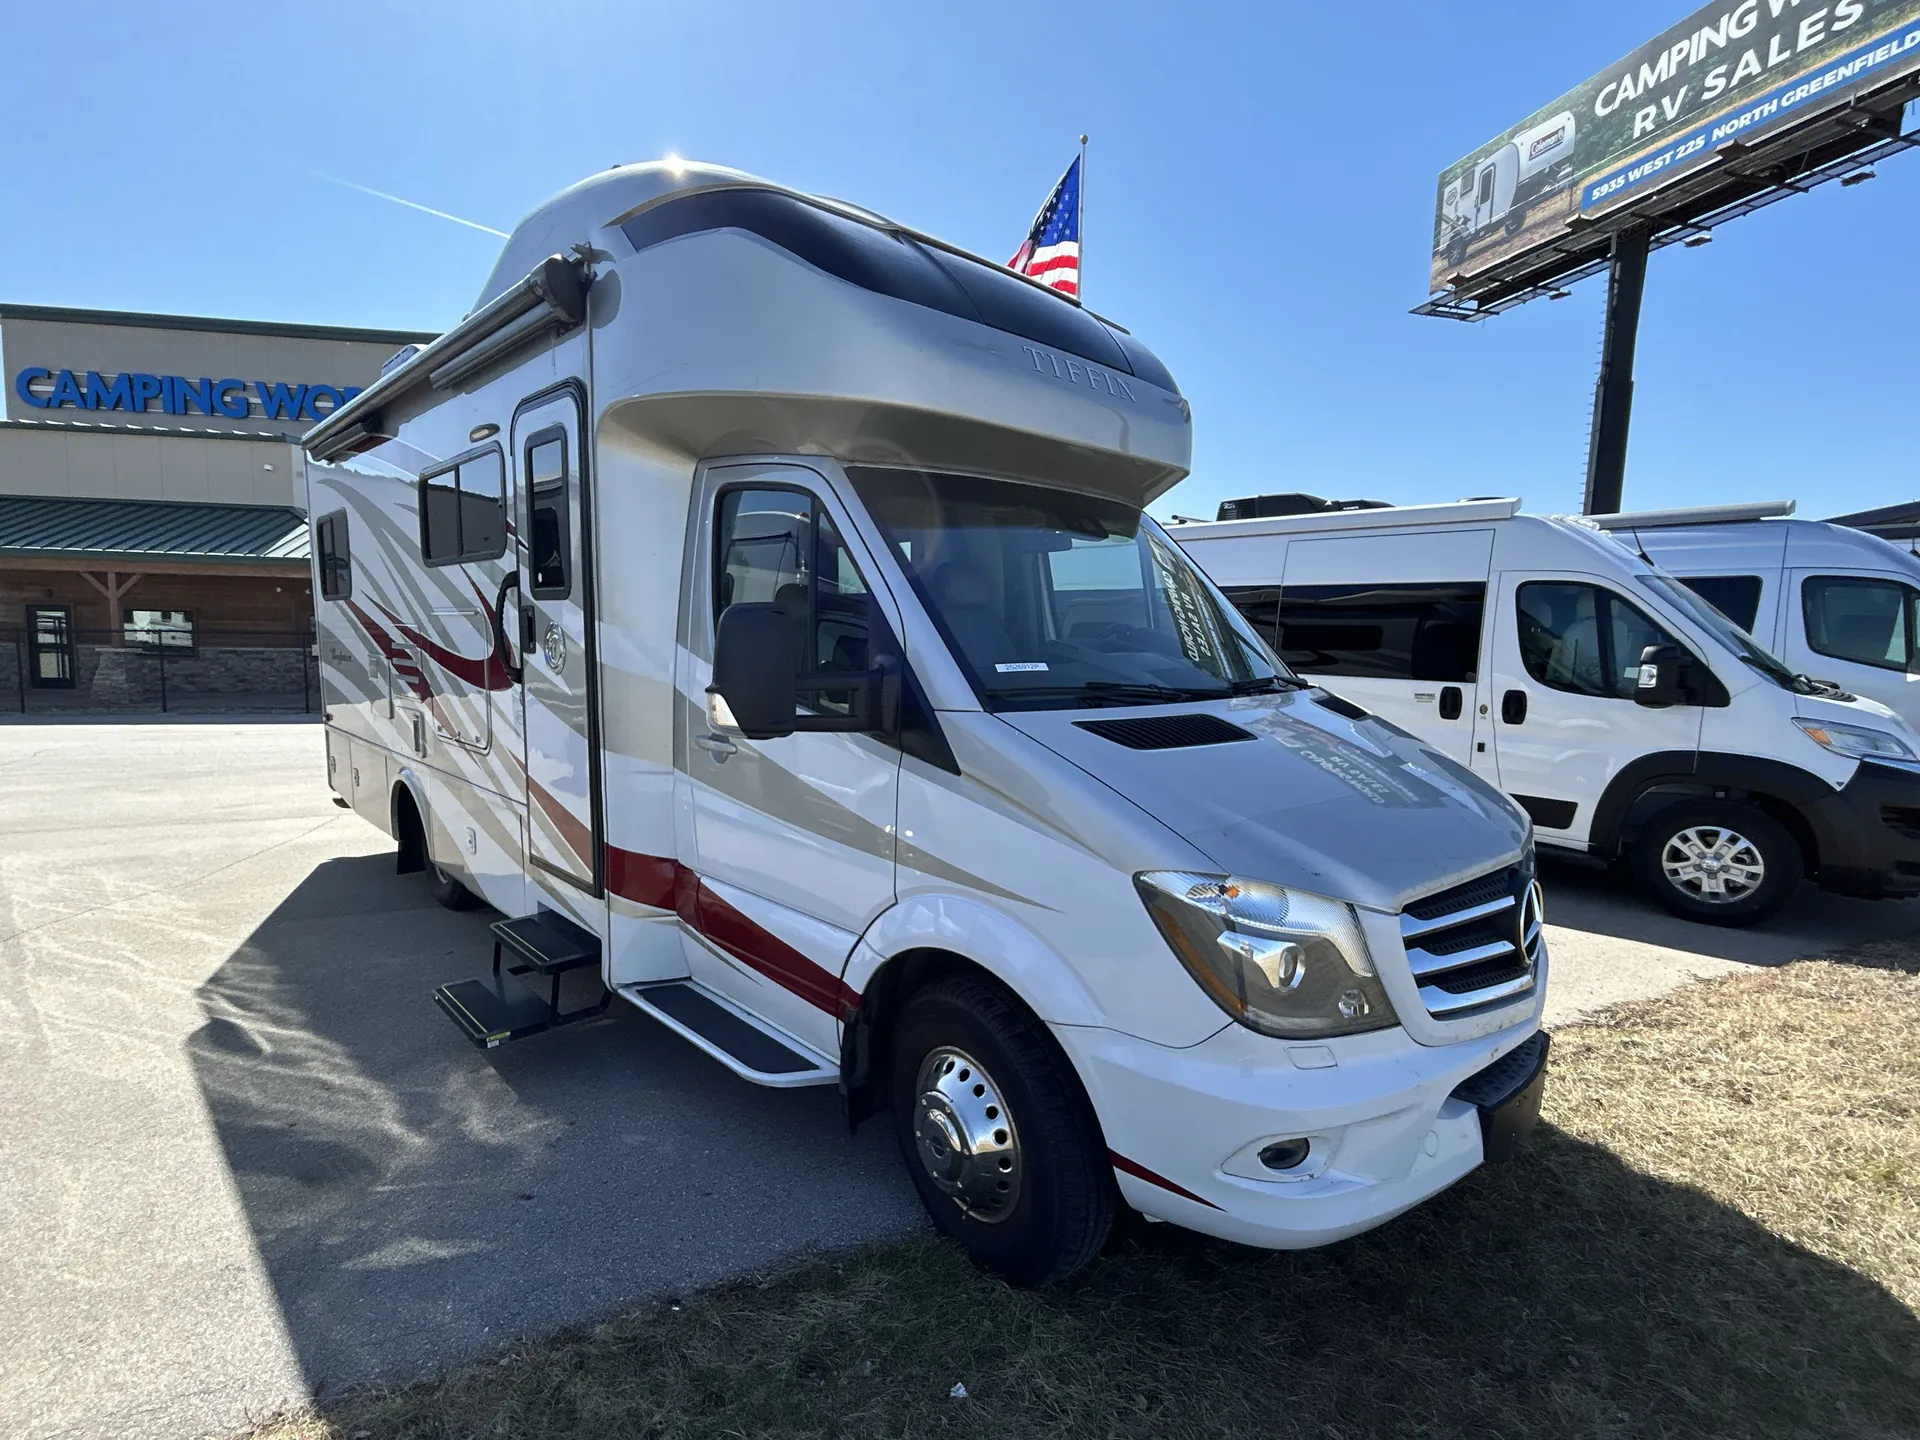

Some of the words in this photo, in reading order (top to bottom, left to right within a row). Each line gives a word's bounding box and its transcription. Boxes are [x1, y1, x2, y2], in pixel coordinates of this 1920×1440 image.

[1591, 175, 1625, 201] 5935
[1628, 151, 1674, 182] WEST
[1674, 135, 1706, 160] 225
[1711, 98, 1779, 142] NORTH
[1780, 30, 1920, 108] GREENFIELD
[1594, 0, 1758, 117] CAMPING
[1633, 84, 1688, 139] RV
[1700, 0, 1864, 100] SALES
[16, 366, 249, 419] CAMPING
[1022, 345, 1136, 404] TIFFIN
